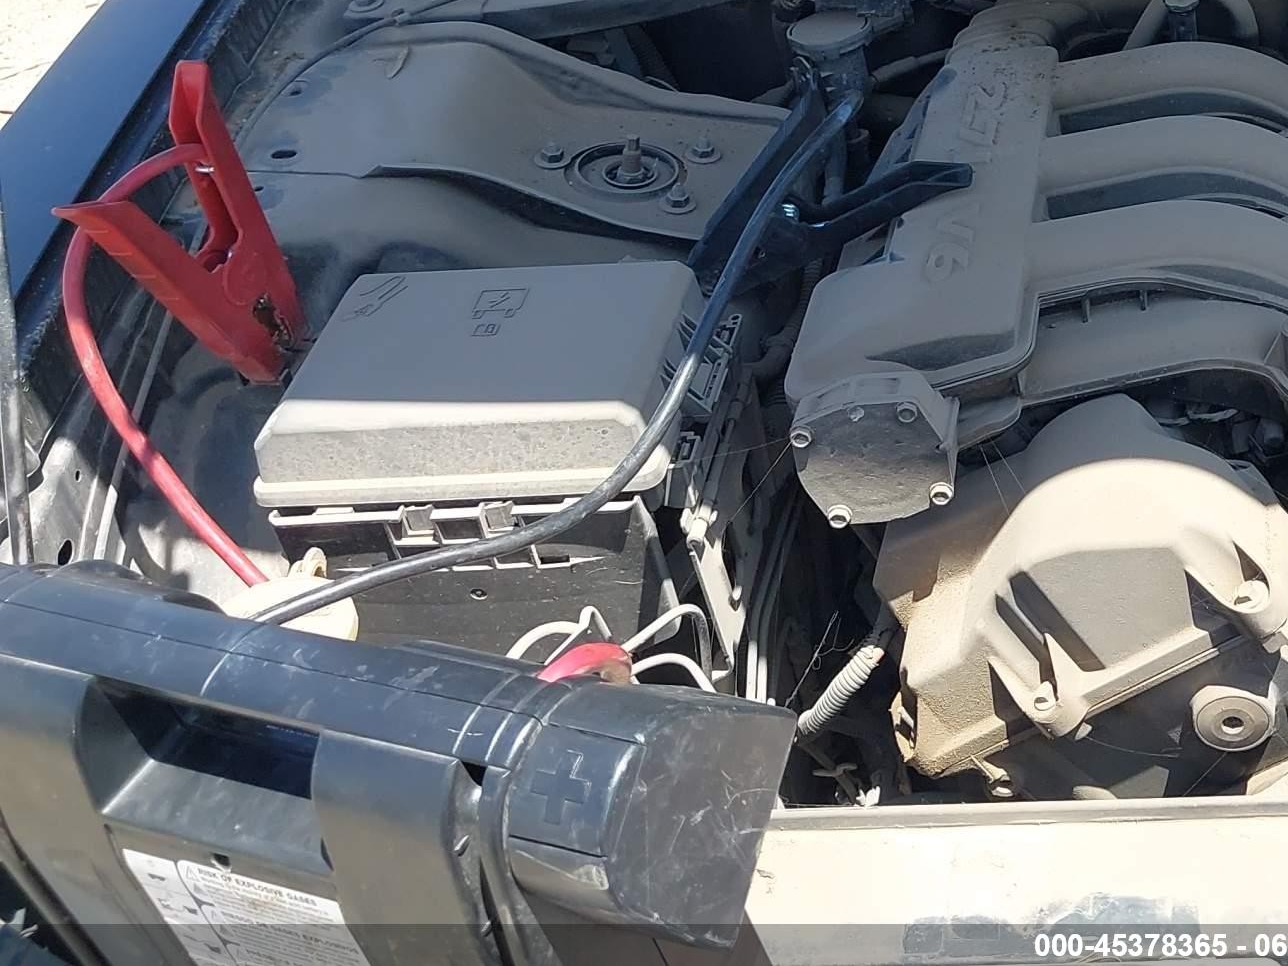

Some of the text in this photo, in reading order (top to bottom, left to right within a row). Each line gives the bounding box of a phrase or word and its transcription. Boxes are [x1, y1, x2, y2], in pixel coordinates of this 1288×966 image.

[220, 874, 232, 883] OF
[234, 878, 284, 898] EXPLOSIVE
[286, 891, 318, 907] GASES
